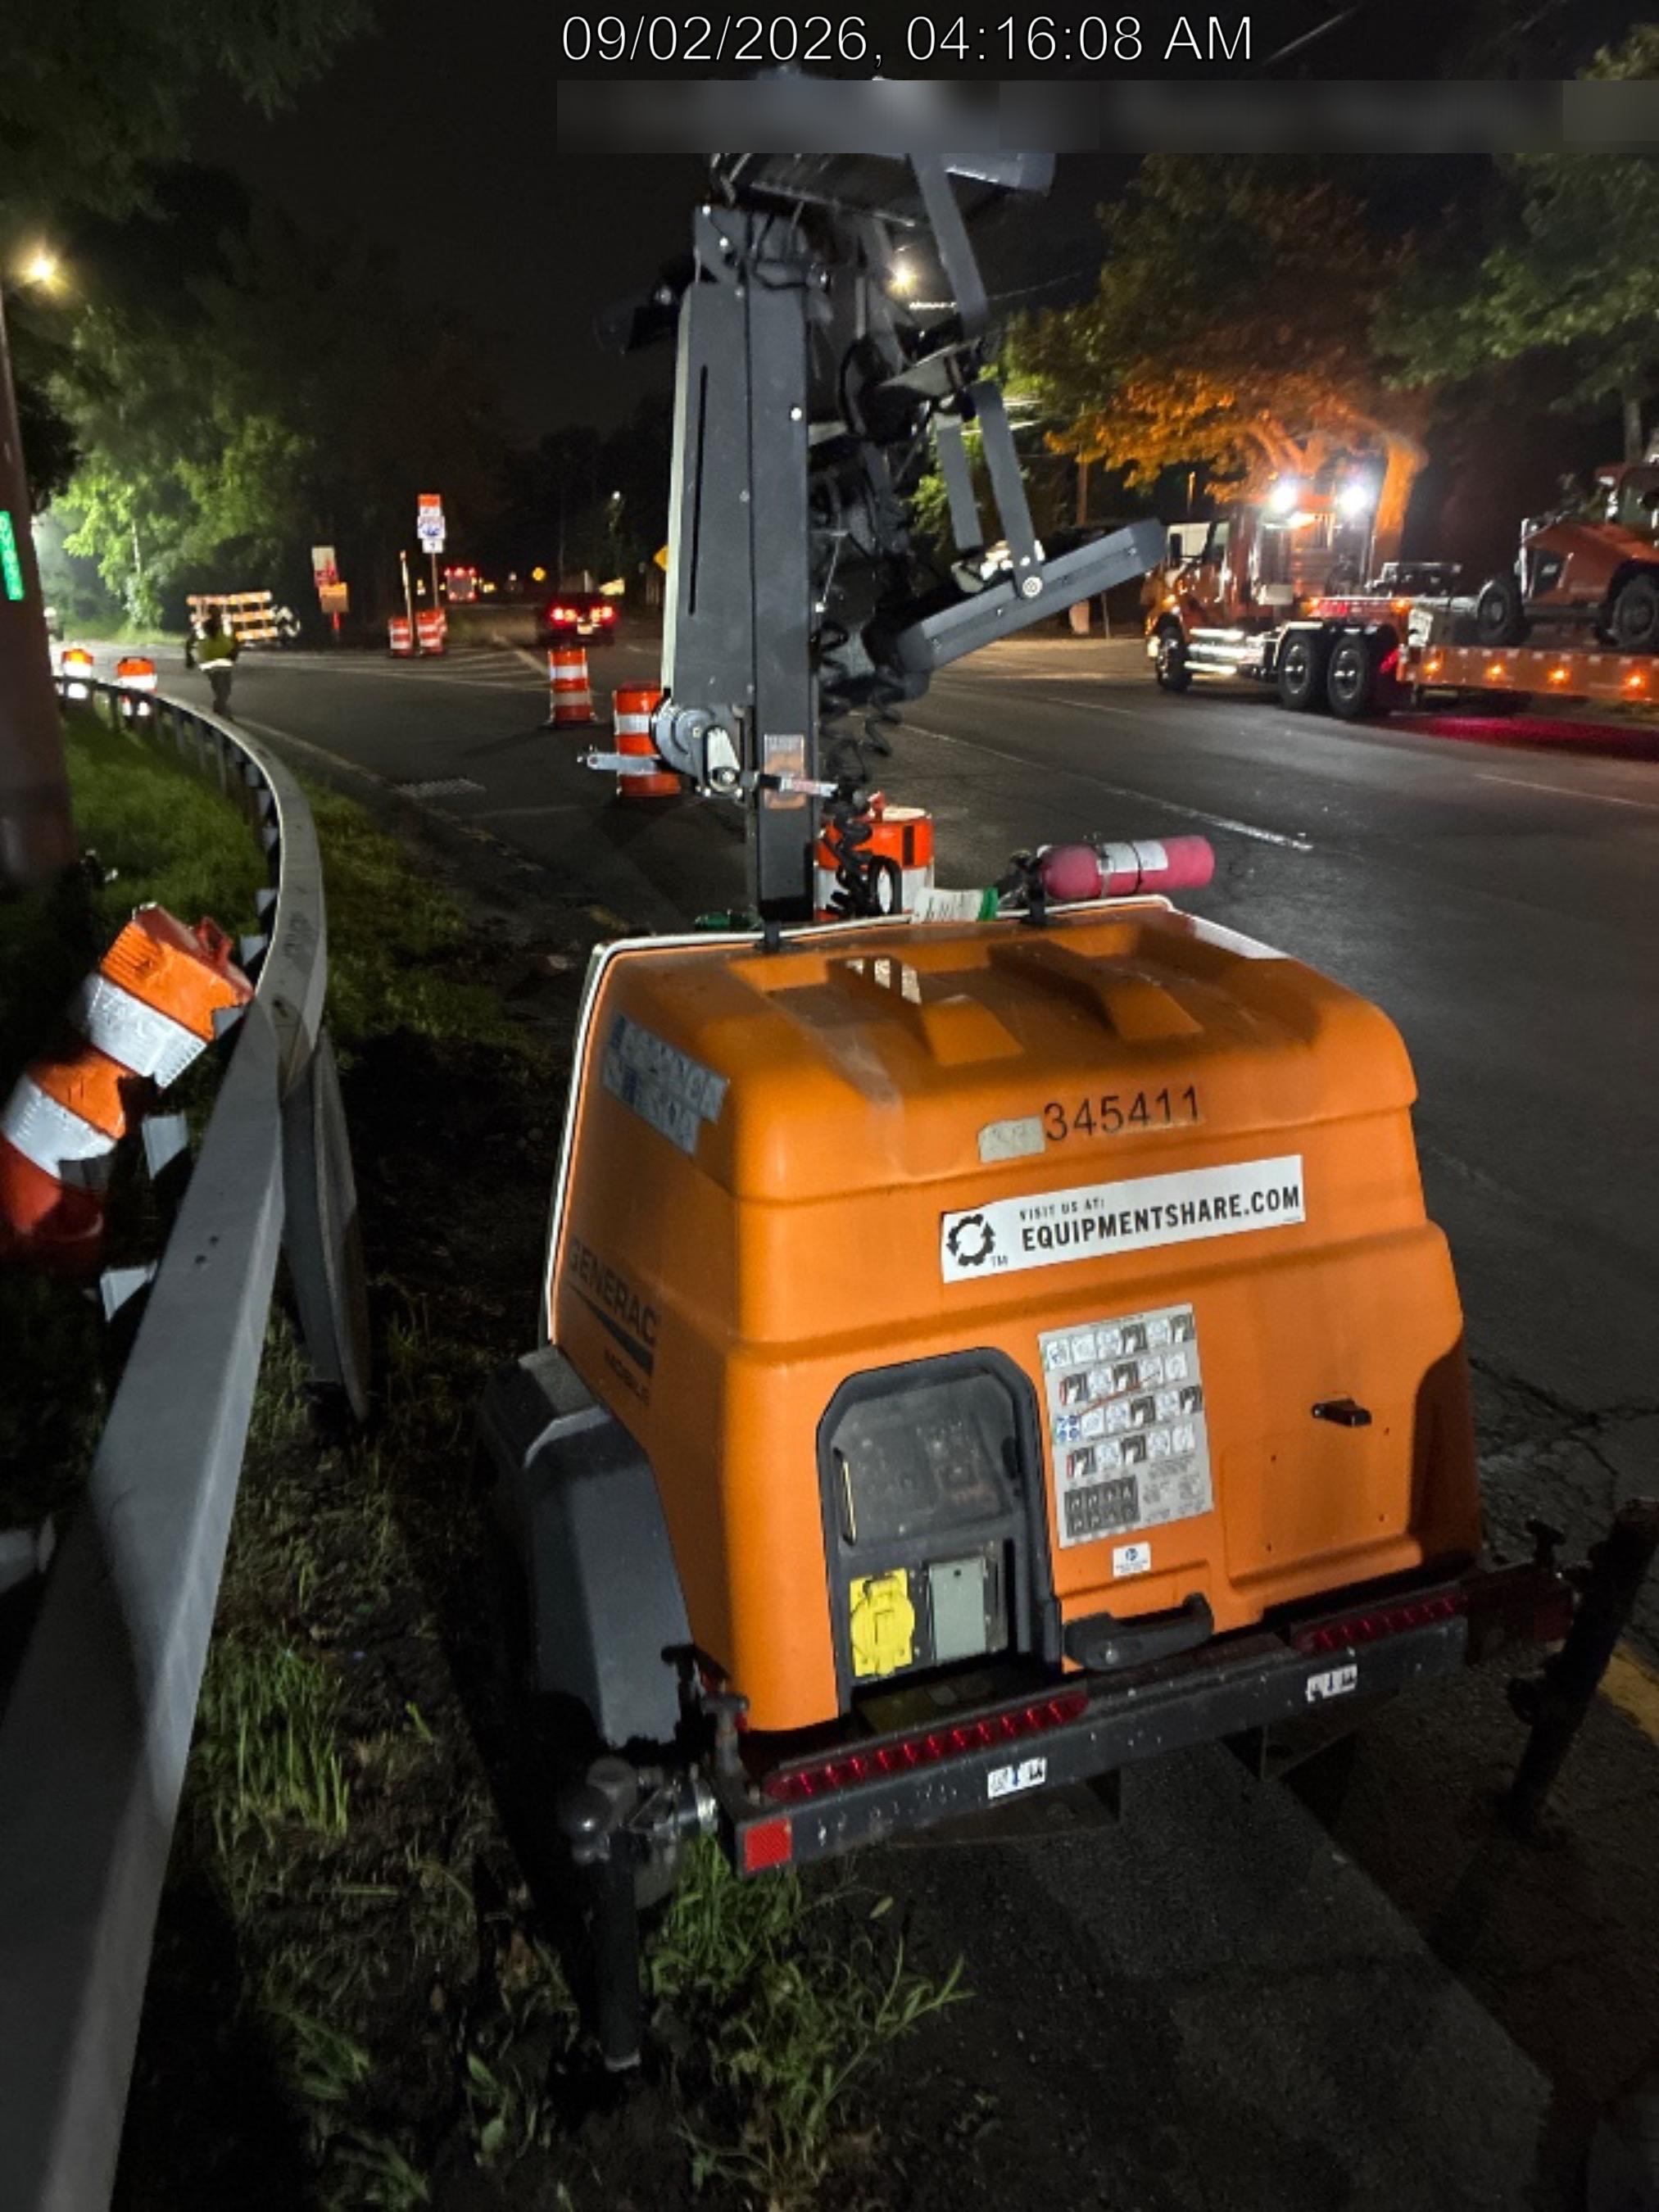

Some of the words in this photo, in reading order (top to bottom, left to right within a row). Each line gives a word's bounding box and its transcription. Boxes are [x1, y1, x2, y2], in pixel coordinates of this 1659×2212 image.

[1044, 1086, 1199, 1141] 345411
[1019, 1204, 1055, 1220] VISIT
[1062, 1201, 1077, 1215] US
[1022, 1185, 1299, 1251] EQUIPMENTSHARE.COM
[569, 1236, 657, 1348] GENERAC
